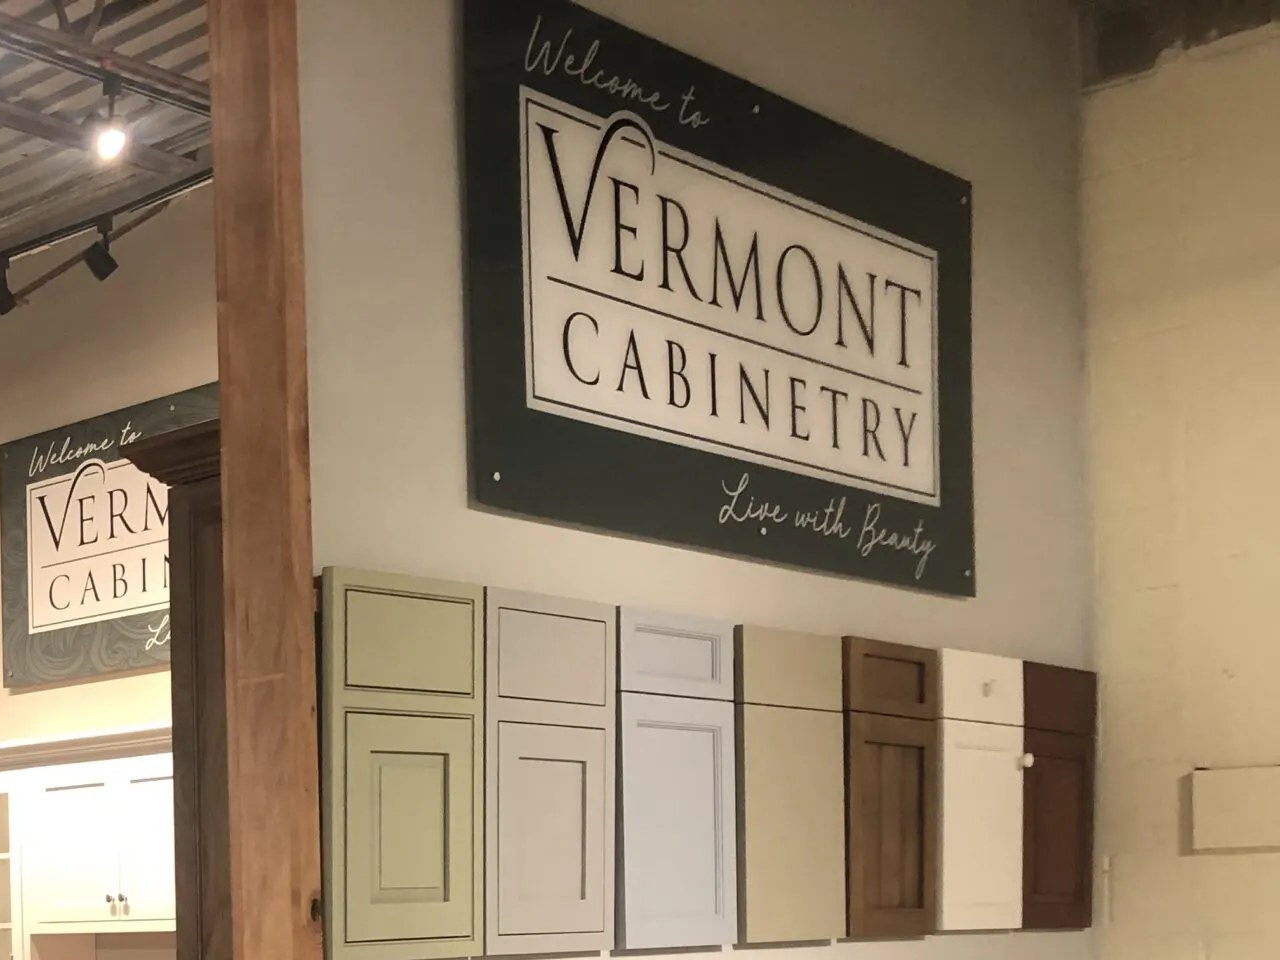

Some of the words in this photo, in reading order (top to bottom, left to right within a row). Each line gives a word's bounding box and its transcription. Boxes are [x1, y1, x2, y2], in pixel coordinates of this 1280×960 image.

[525, 15, 670, 111] Welcome
[679, 86, 710, 128] to
[536, 117, 922, 369] VERMONT
[562, 311, 918, 468] CABINETRY
[28, 437, 115, 477] Welcome
[121, 421, 142, 446] to
[719, 473, 789, 523] Live
[795, 497, 851, 538] with
[858, 503, 936, 579] Beauty
